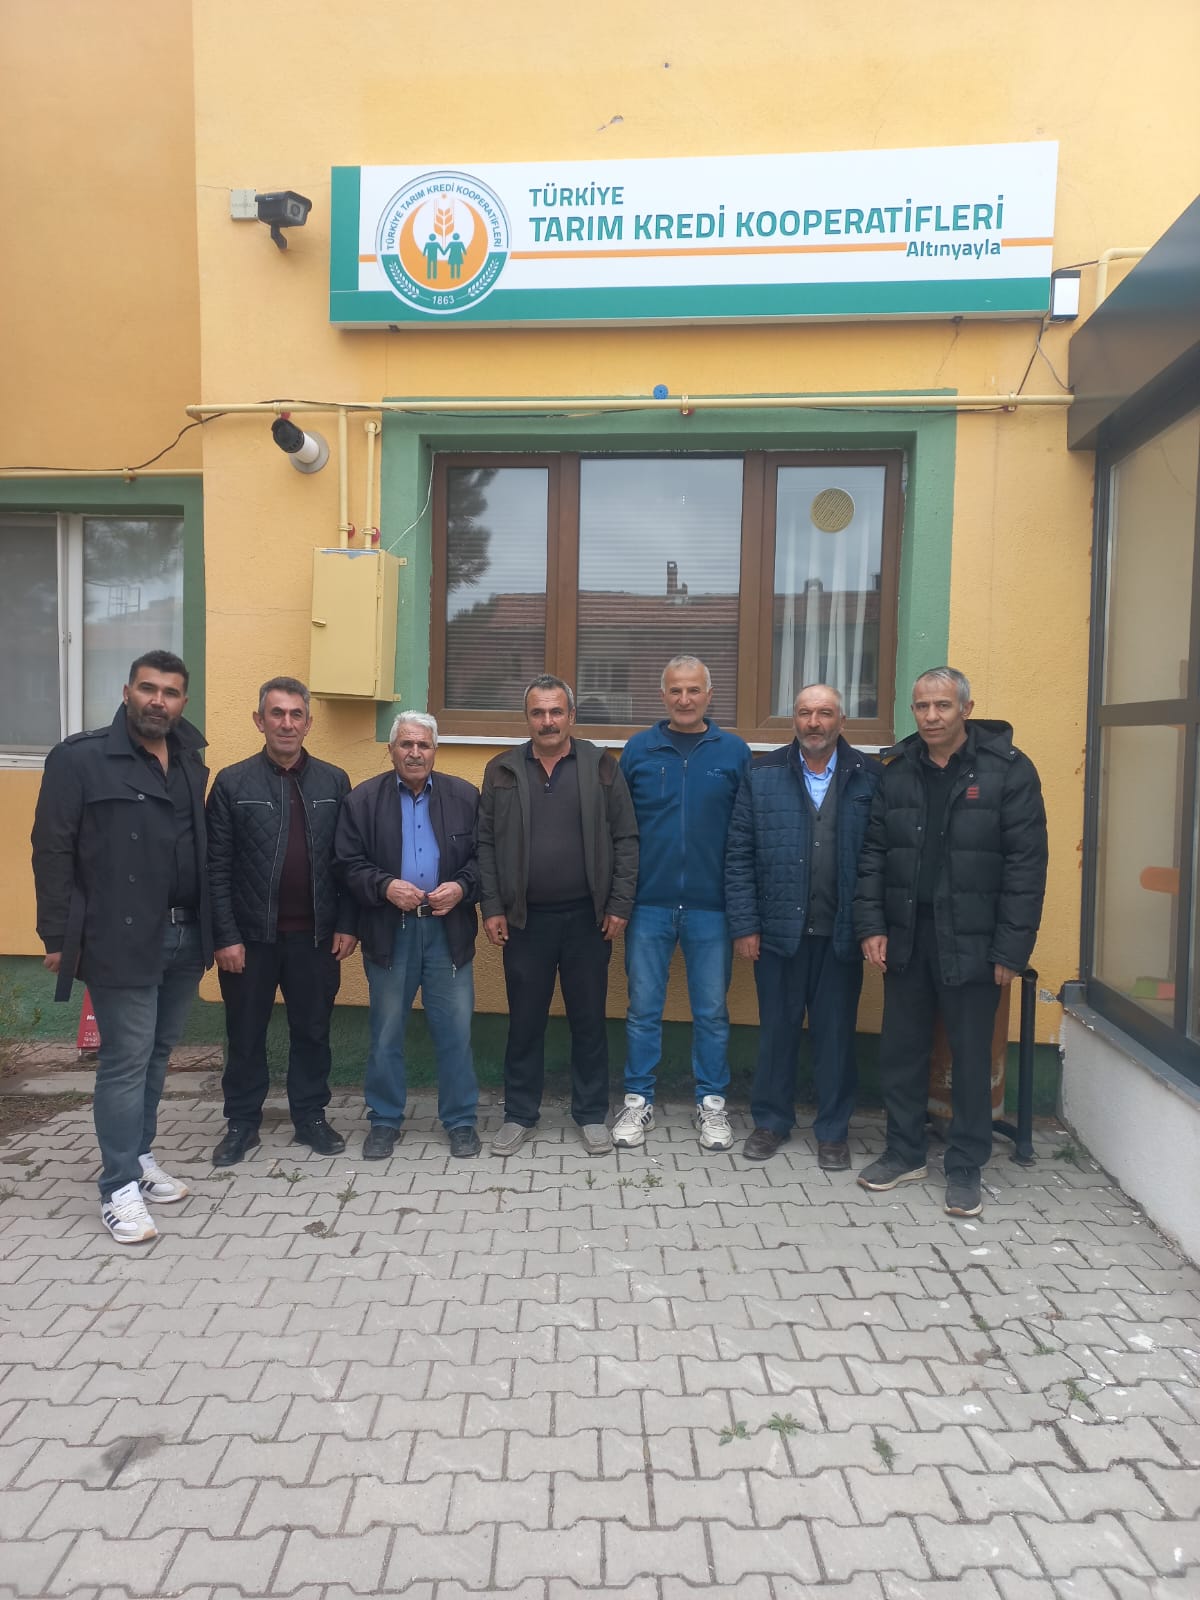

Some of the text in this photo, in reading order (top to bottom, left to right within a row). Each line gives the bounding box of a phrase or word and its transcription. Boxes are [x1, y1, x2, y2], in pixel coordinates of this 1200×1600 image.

[528, 181, 625, 207] TÜRKİYE
[386, 182, 504, 250] TÜRKİYE TARIM KREDİ KOOPERATİFLERİ
[528, 194, 1004, 242] TARIM KREDİ KOOPERATİFLERİ
[906, 238, 1001, 261] Altınyayla
[432, 295, 455, 305] 1863
